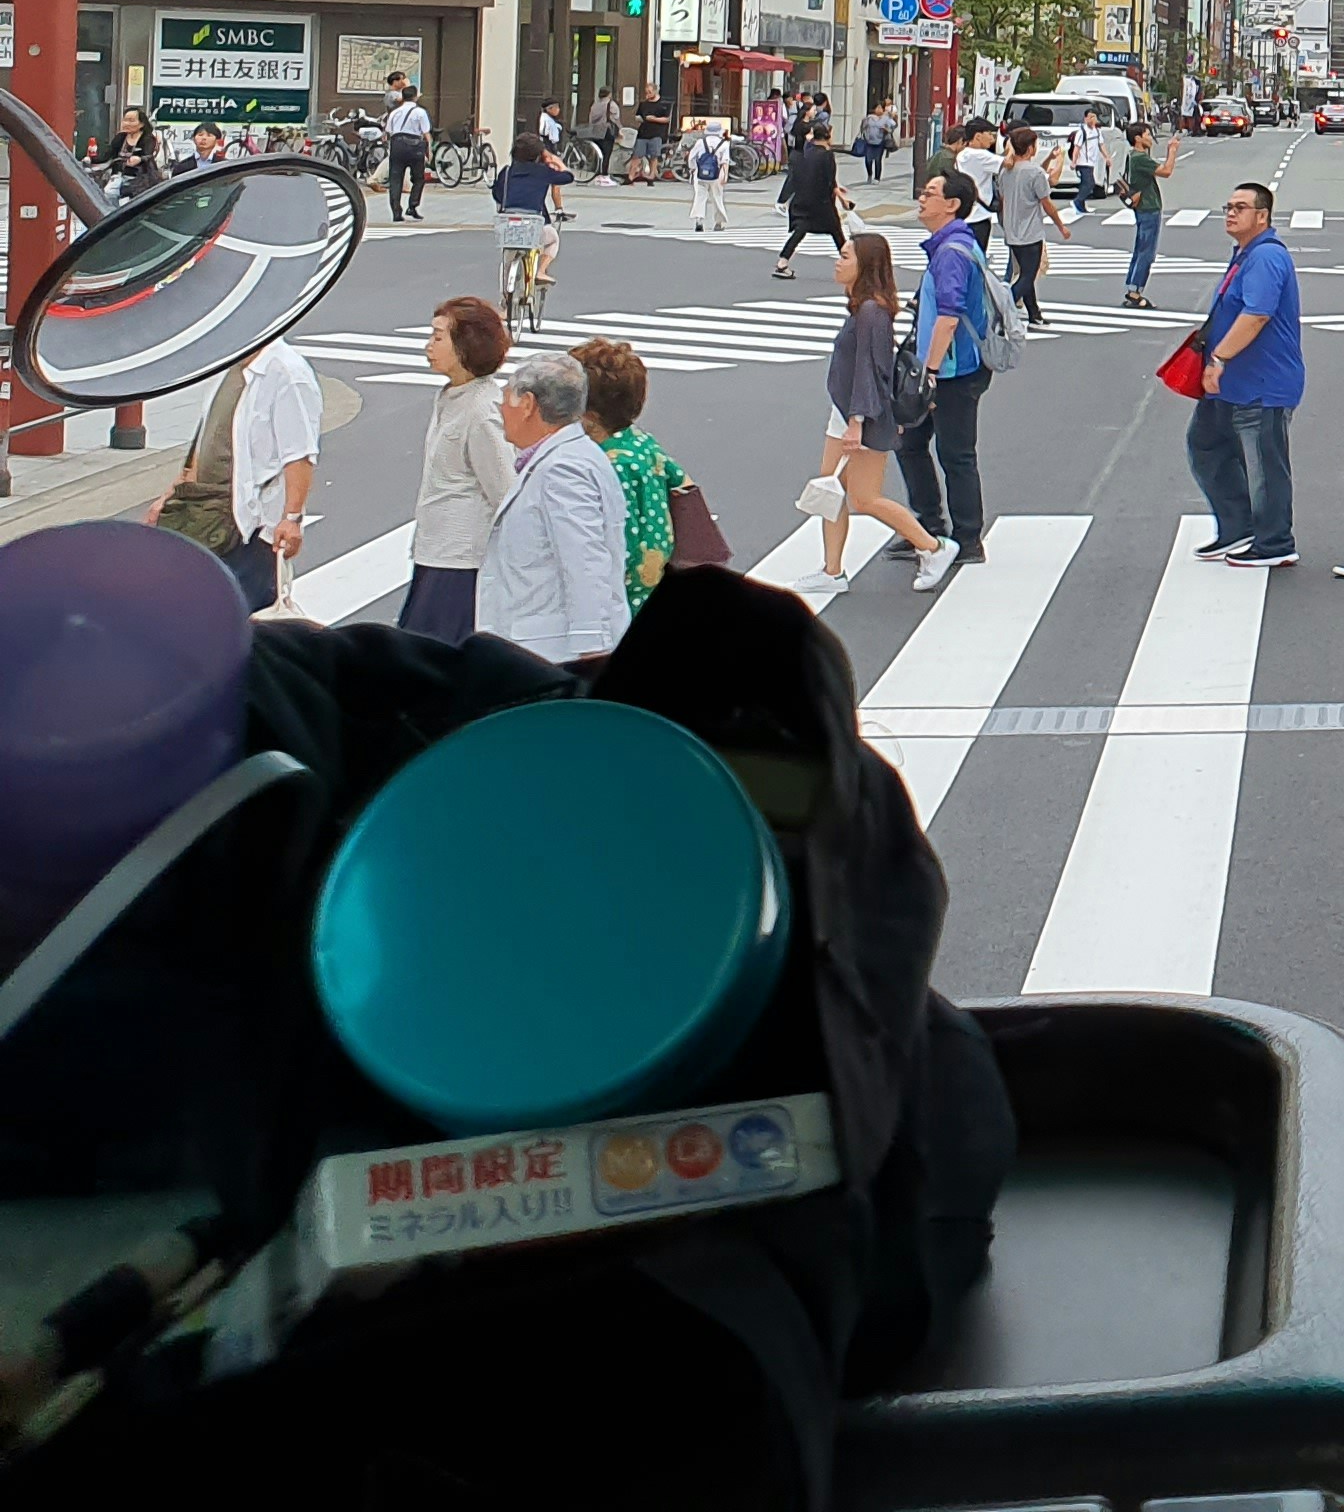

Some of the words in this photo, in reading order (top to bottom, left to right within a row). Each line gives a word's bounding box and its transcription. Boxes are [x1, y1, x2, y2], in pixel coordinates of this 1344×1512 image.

[216, 28, 275, 47] SMBC
[159, 57, 304, 81] 三井住友銀行
[368, 1136, 565, 1206] 期間限定
